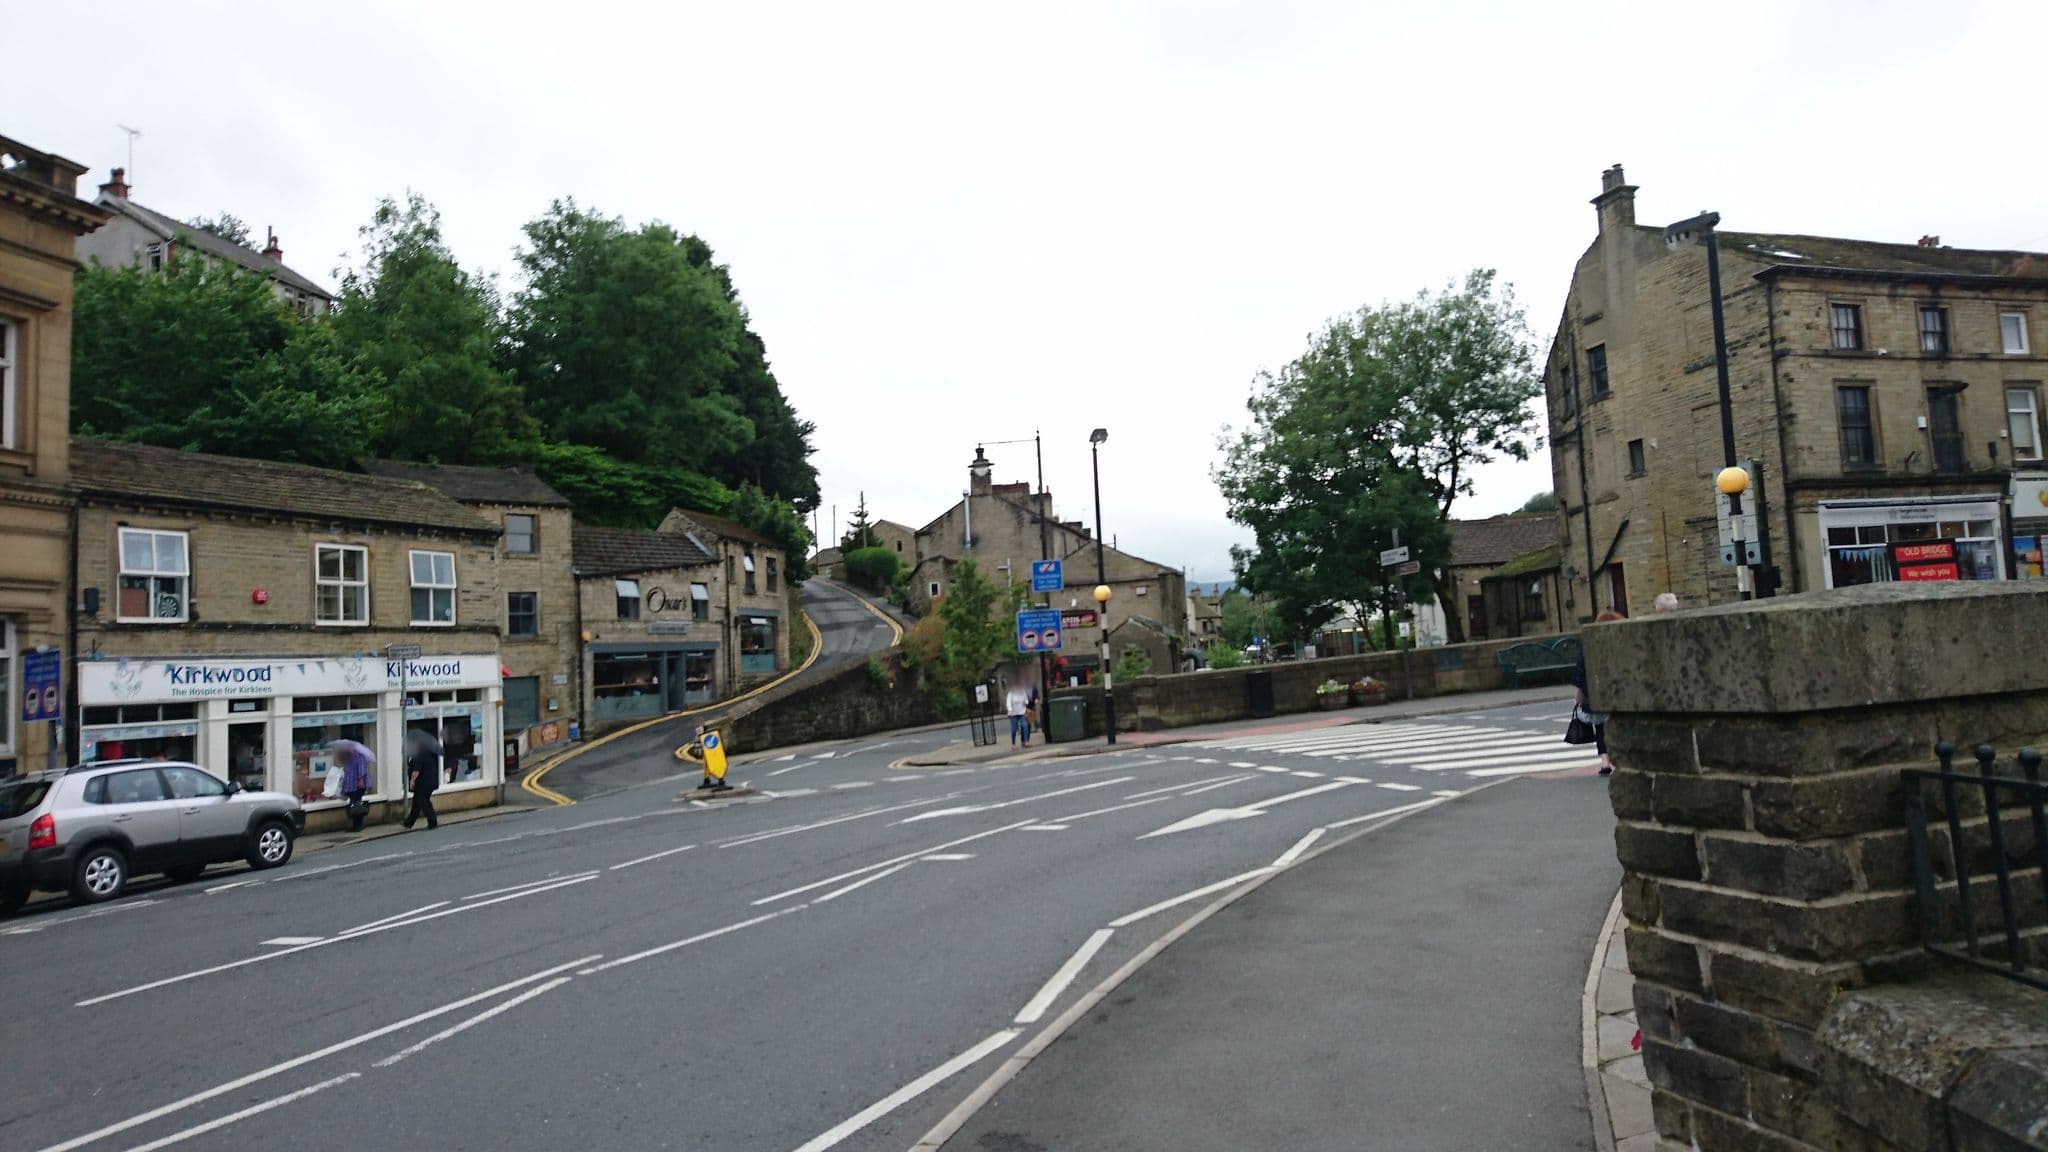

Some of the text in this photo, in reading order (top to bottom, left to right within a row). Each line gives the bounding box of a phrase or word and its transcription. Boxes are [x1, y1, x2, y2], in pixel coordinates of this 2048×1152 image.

[1904, 546, 1920, 556] OLD
[1937, 567, 1950, 577] you
[171, 664, 271, 684] Kirkwood
[172, 688, 186, 696] The
[189, 687, 222, 696] Hospice
[225, 686, 236, 694] for
